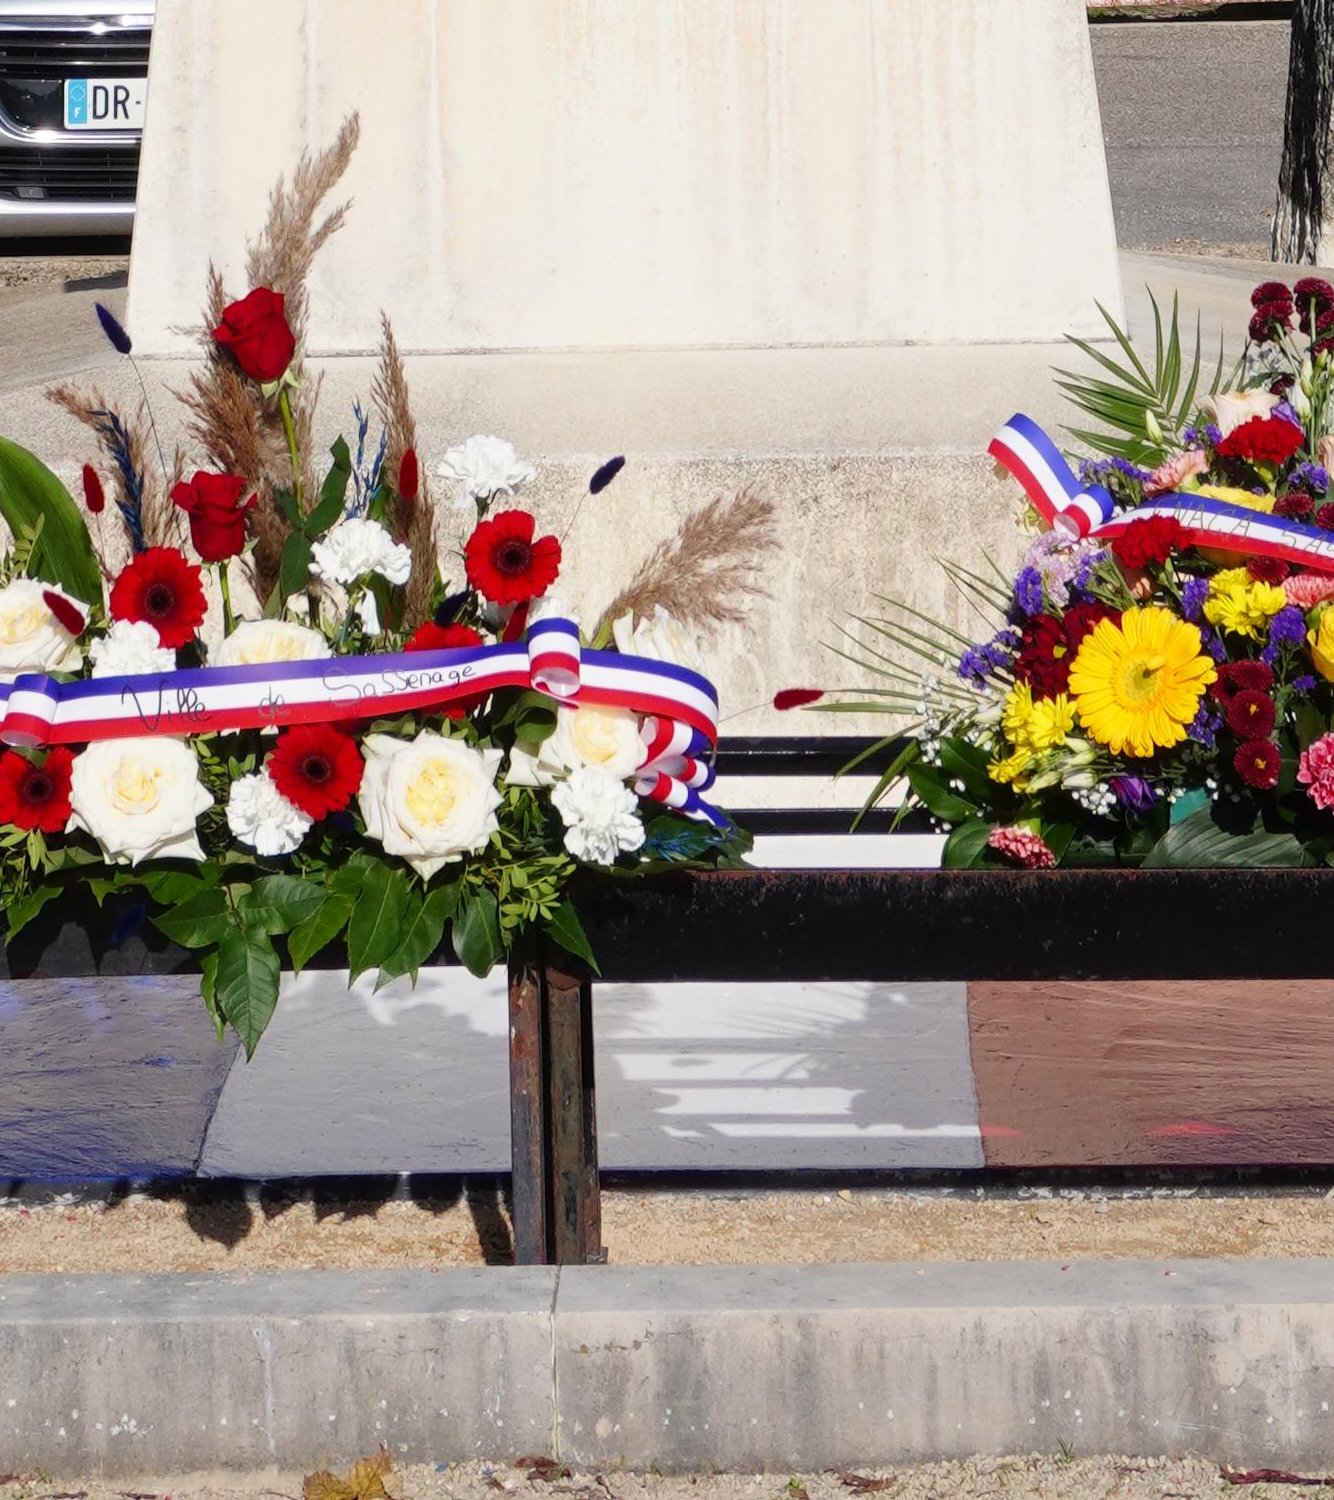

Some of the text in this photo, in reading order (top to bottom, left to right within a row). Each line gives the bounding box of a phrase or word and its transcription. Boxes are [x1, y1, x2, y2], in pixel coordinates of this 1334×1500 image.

[121, 663, 477, 733] Ville de Sassenage
